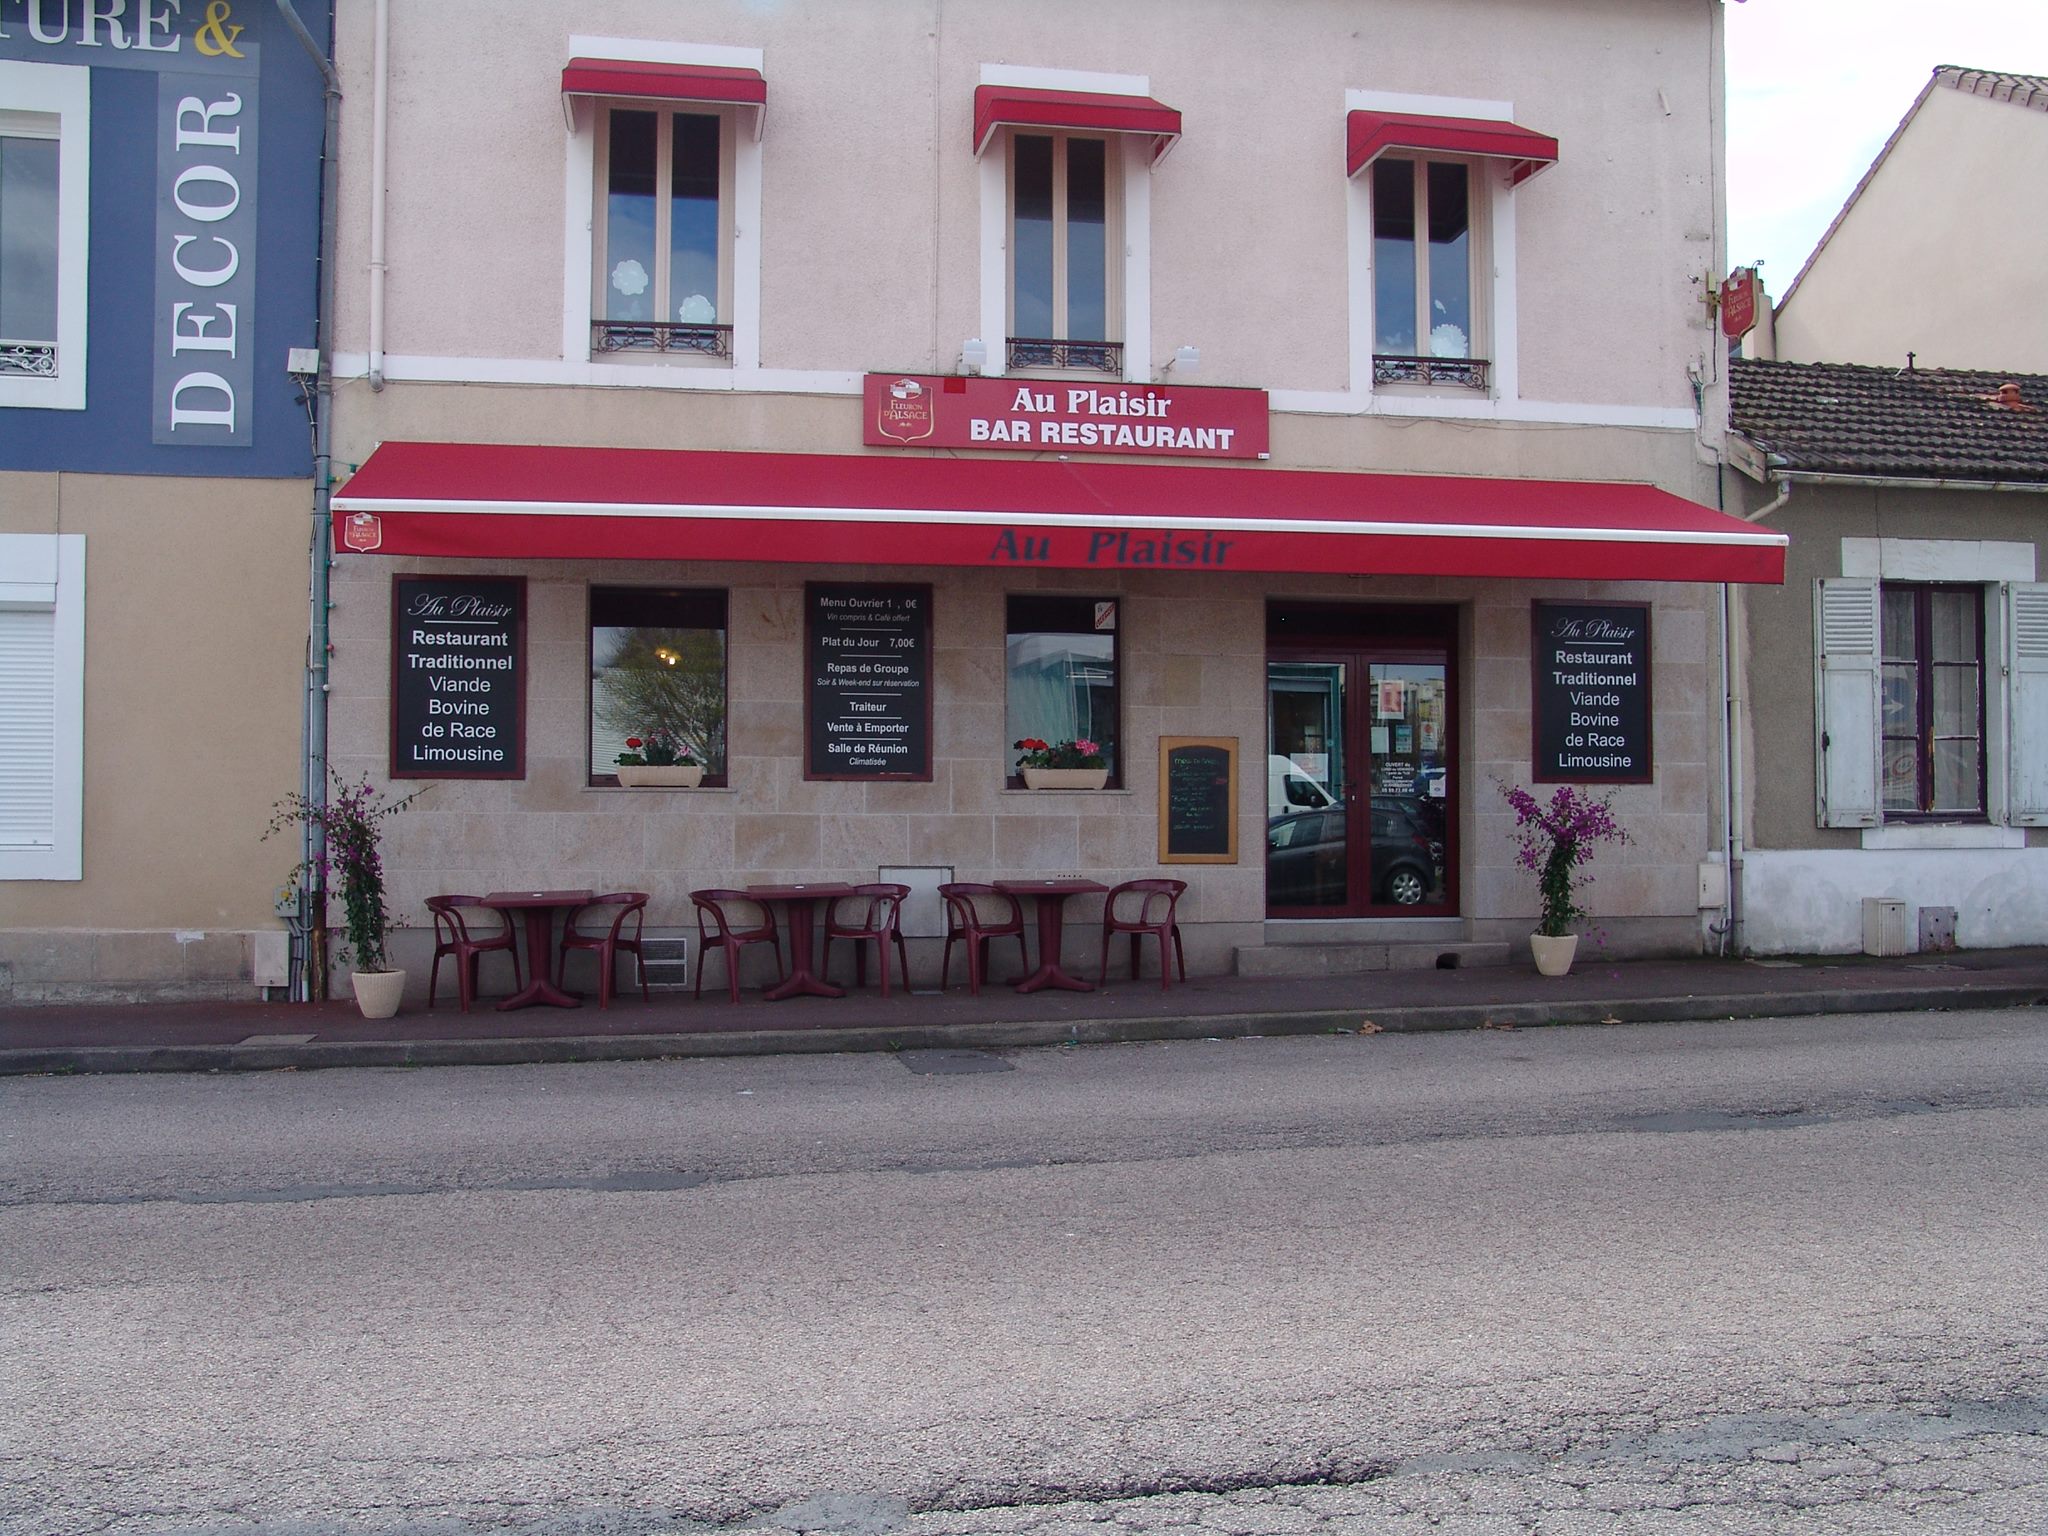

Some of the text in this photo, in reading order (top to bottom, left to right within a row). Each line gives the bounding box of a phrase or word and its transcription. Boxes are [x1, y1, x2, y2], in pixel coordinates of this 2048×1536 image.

[194, 0, 245, 58] &
[171, 92, 242, 432] DECOR
[1011, 388, 1172, 417] Au Plaisir
[970, 419, 1234, 450] BAR RESTAURANT
[990, 530, 1235, 566] Au Plaisir
[407, 593, 512, 617] Au Plaisir
[821, 598, 846, 607] Menu
[849, 598, 884, 607] Ouvrier
[1551, 617, 1635, 639] Au Plaisir
[413, 630, 507, 646] Restaurant
[823, 637, 914, 648] Plat du Jour 7,00€
[408, 654, 511, 669] Traditionnel
[1556, 651, 1632, 664] Restaurant
[828, 663, 908, 675] Repas de Groupe
[429, 676, 490, 692] Viande
[1553, 672, 1636, 685] Traditionnel
[1570, 692, 1619, 705] Viande
[430, 699, 489, 715] Bovine
[850, 702, 886, 711] Traiteur
[1571, 712, 1619, 726] Bovine
[422, 722, 495, 738] de Race
[827, 722, 909, 734] Vente à Emporter
[1566, 733, 1624, 746] de Race
[414, 745, 503, 761] Limousine
[828, 743, 907, 753] Salle de Réunion
[849, 757, 886, 765] Climatisée
[1559, 753, 1631, 767] Limousine
